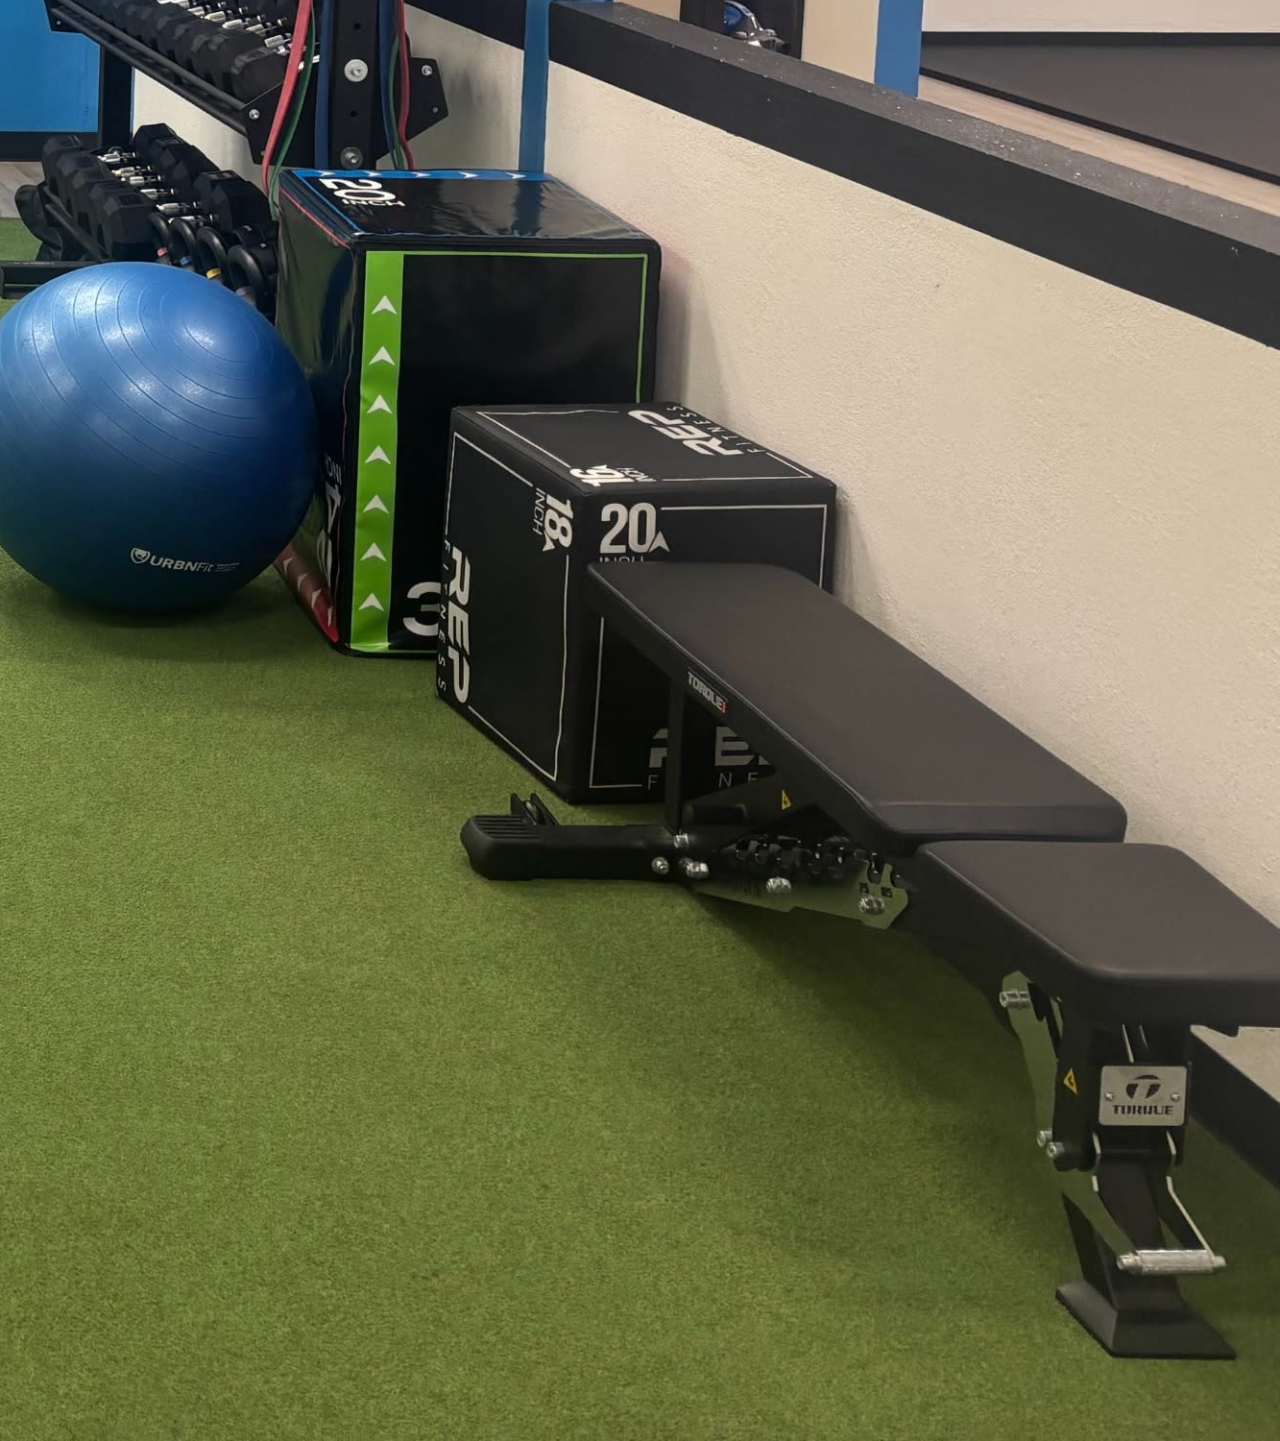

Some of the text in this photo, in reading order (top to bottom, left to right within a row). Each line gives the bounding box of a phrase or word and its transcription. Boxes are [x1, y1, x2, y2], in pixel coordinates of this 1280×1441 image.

[341, 199, 407, 207] INCH
[626, 409, 745, 456] REP
[532, 487, 547, 536] INCH
[543, 494, 575, 549] 18
[599, 502, 657, 554] 20
[447, 545, 471, 704] REP
